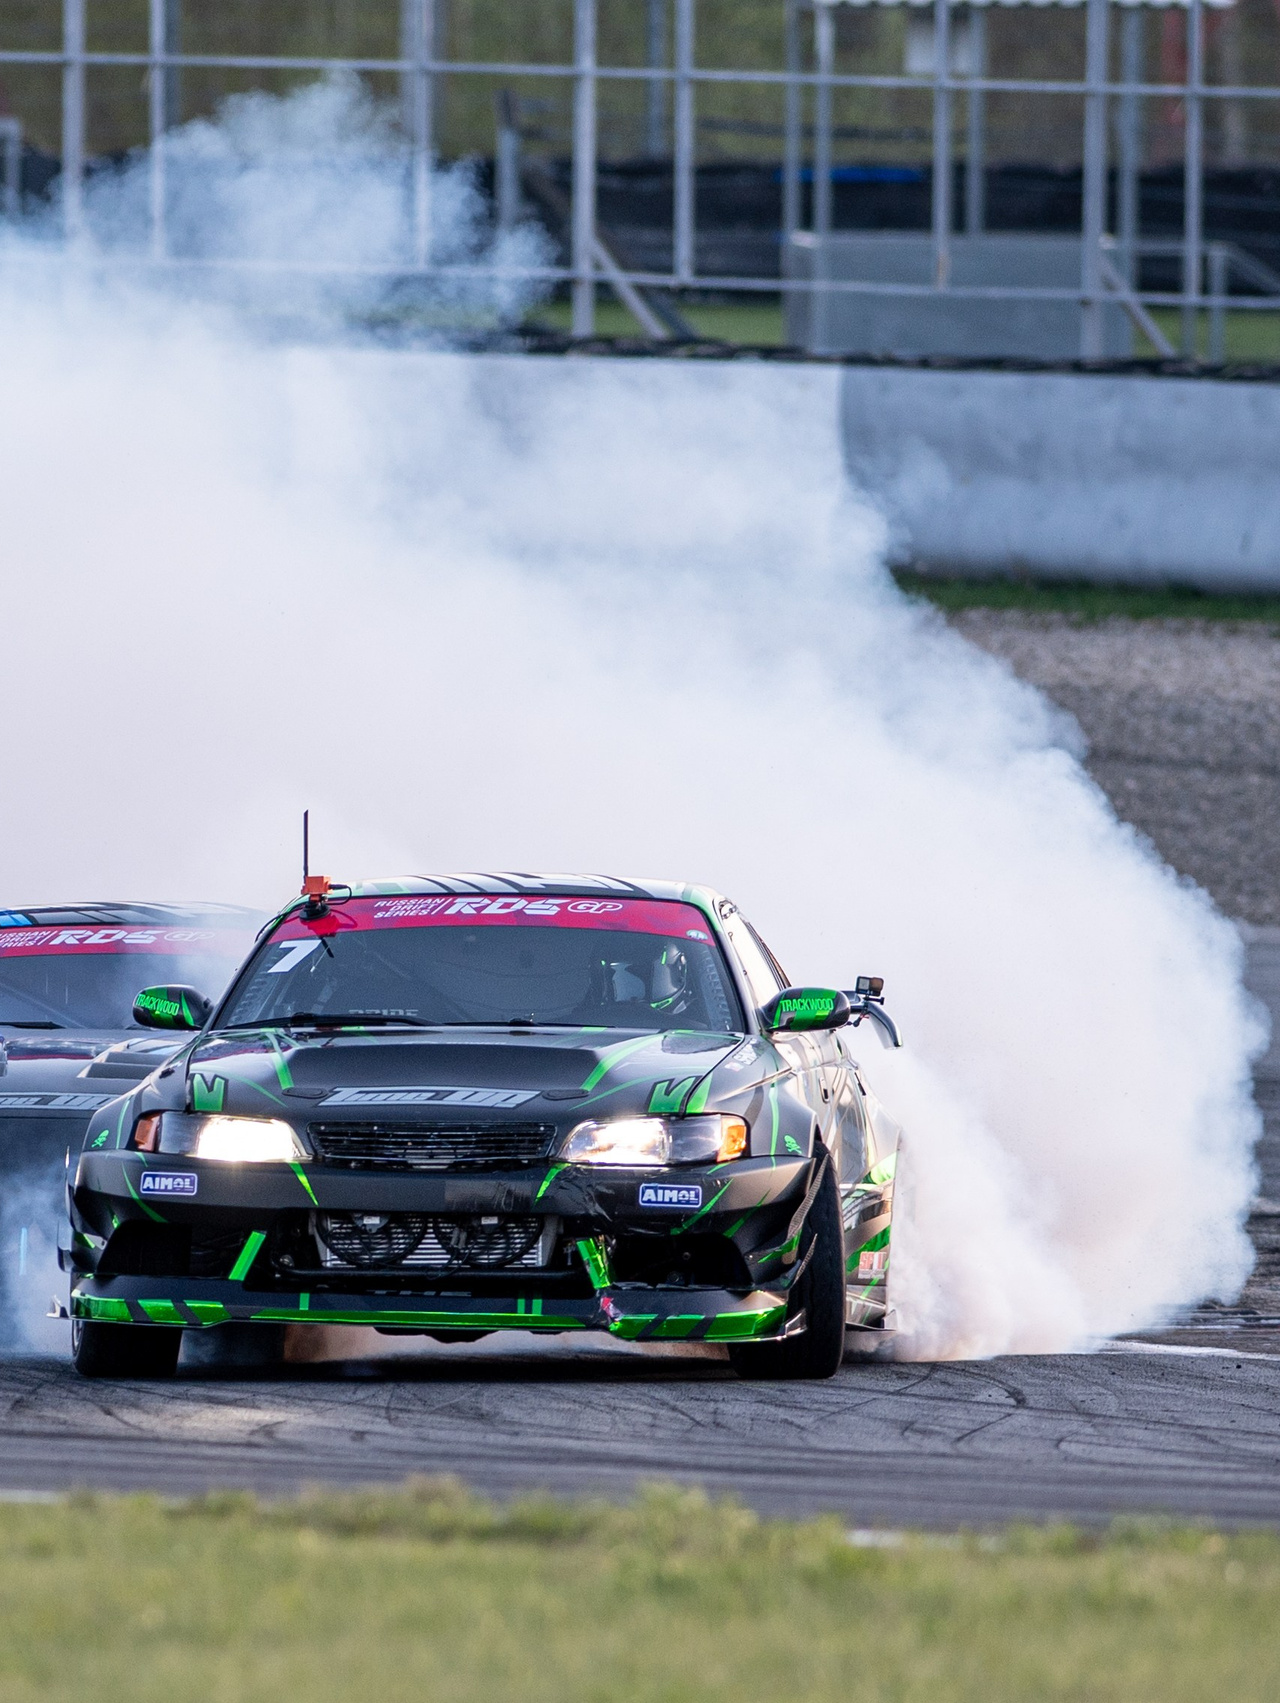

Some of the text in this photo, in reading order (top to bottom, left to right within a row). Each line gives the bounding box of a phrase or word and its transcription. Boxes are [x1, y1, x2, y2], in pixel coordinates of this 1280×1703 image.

[374, 898, 445, 907] RUSSIAN
[389, 903, 440, 912] DRIFT
[443, 897, 624, 915] RDS GP
[373, 909, 431, 919] SERIES
[0, 935, 43, 944] DRIFT
[48, 929, 168, 945] RDS
[267, 939, 322, 973] 7
[135, 993, 180, 1016] TRACKWOOD
[780, 998, 835, 1012] TRACKWOOD
[142, 1176, 194, 1190] AIMOL
[642, 1188, 699, 1203] AIMOL
